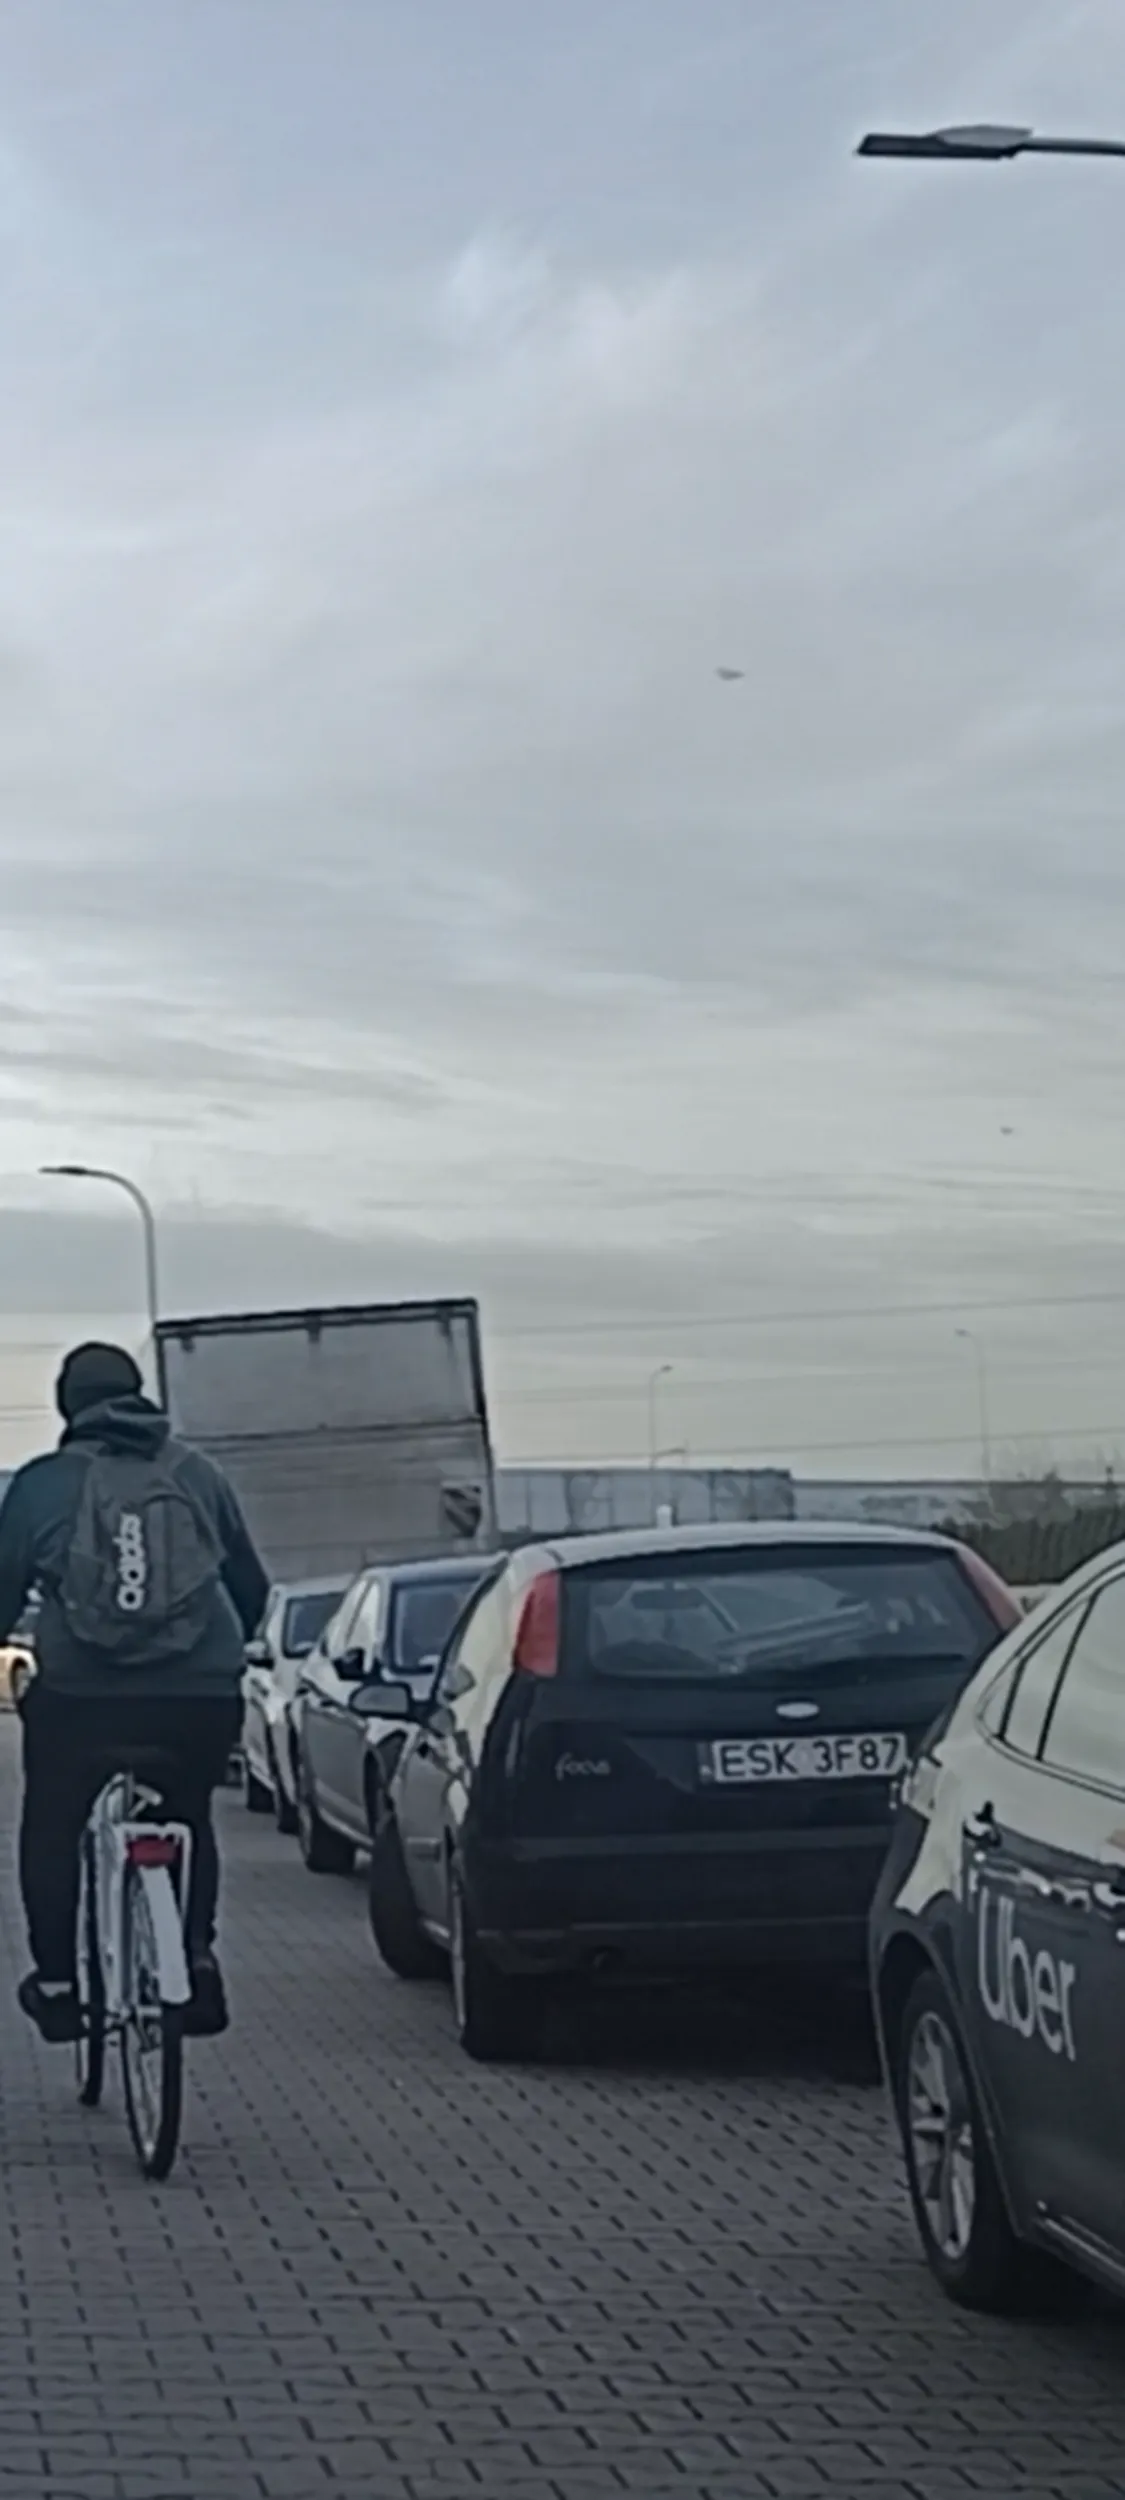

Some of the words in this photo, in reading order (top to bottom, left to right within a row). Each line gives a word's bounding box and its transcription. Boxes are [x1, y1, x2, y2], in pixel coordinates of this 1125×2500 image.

[719, 1742, 798, 1777] ESK
[812, 1736, 900, 1773] 3F87
[978, 1886, 1076, 2061] Uber
